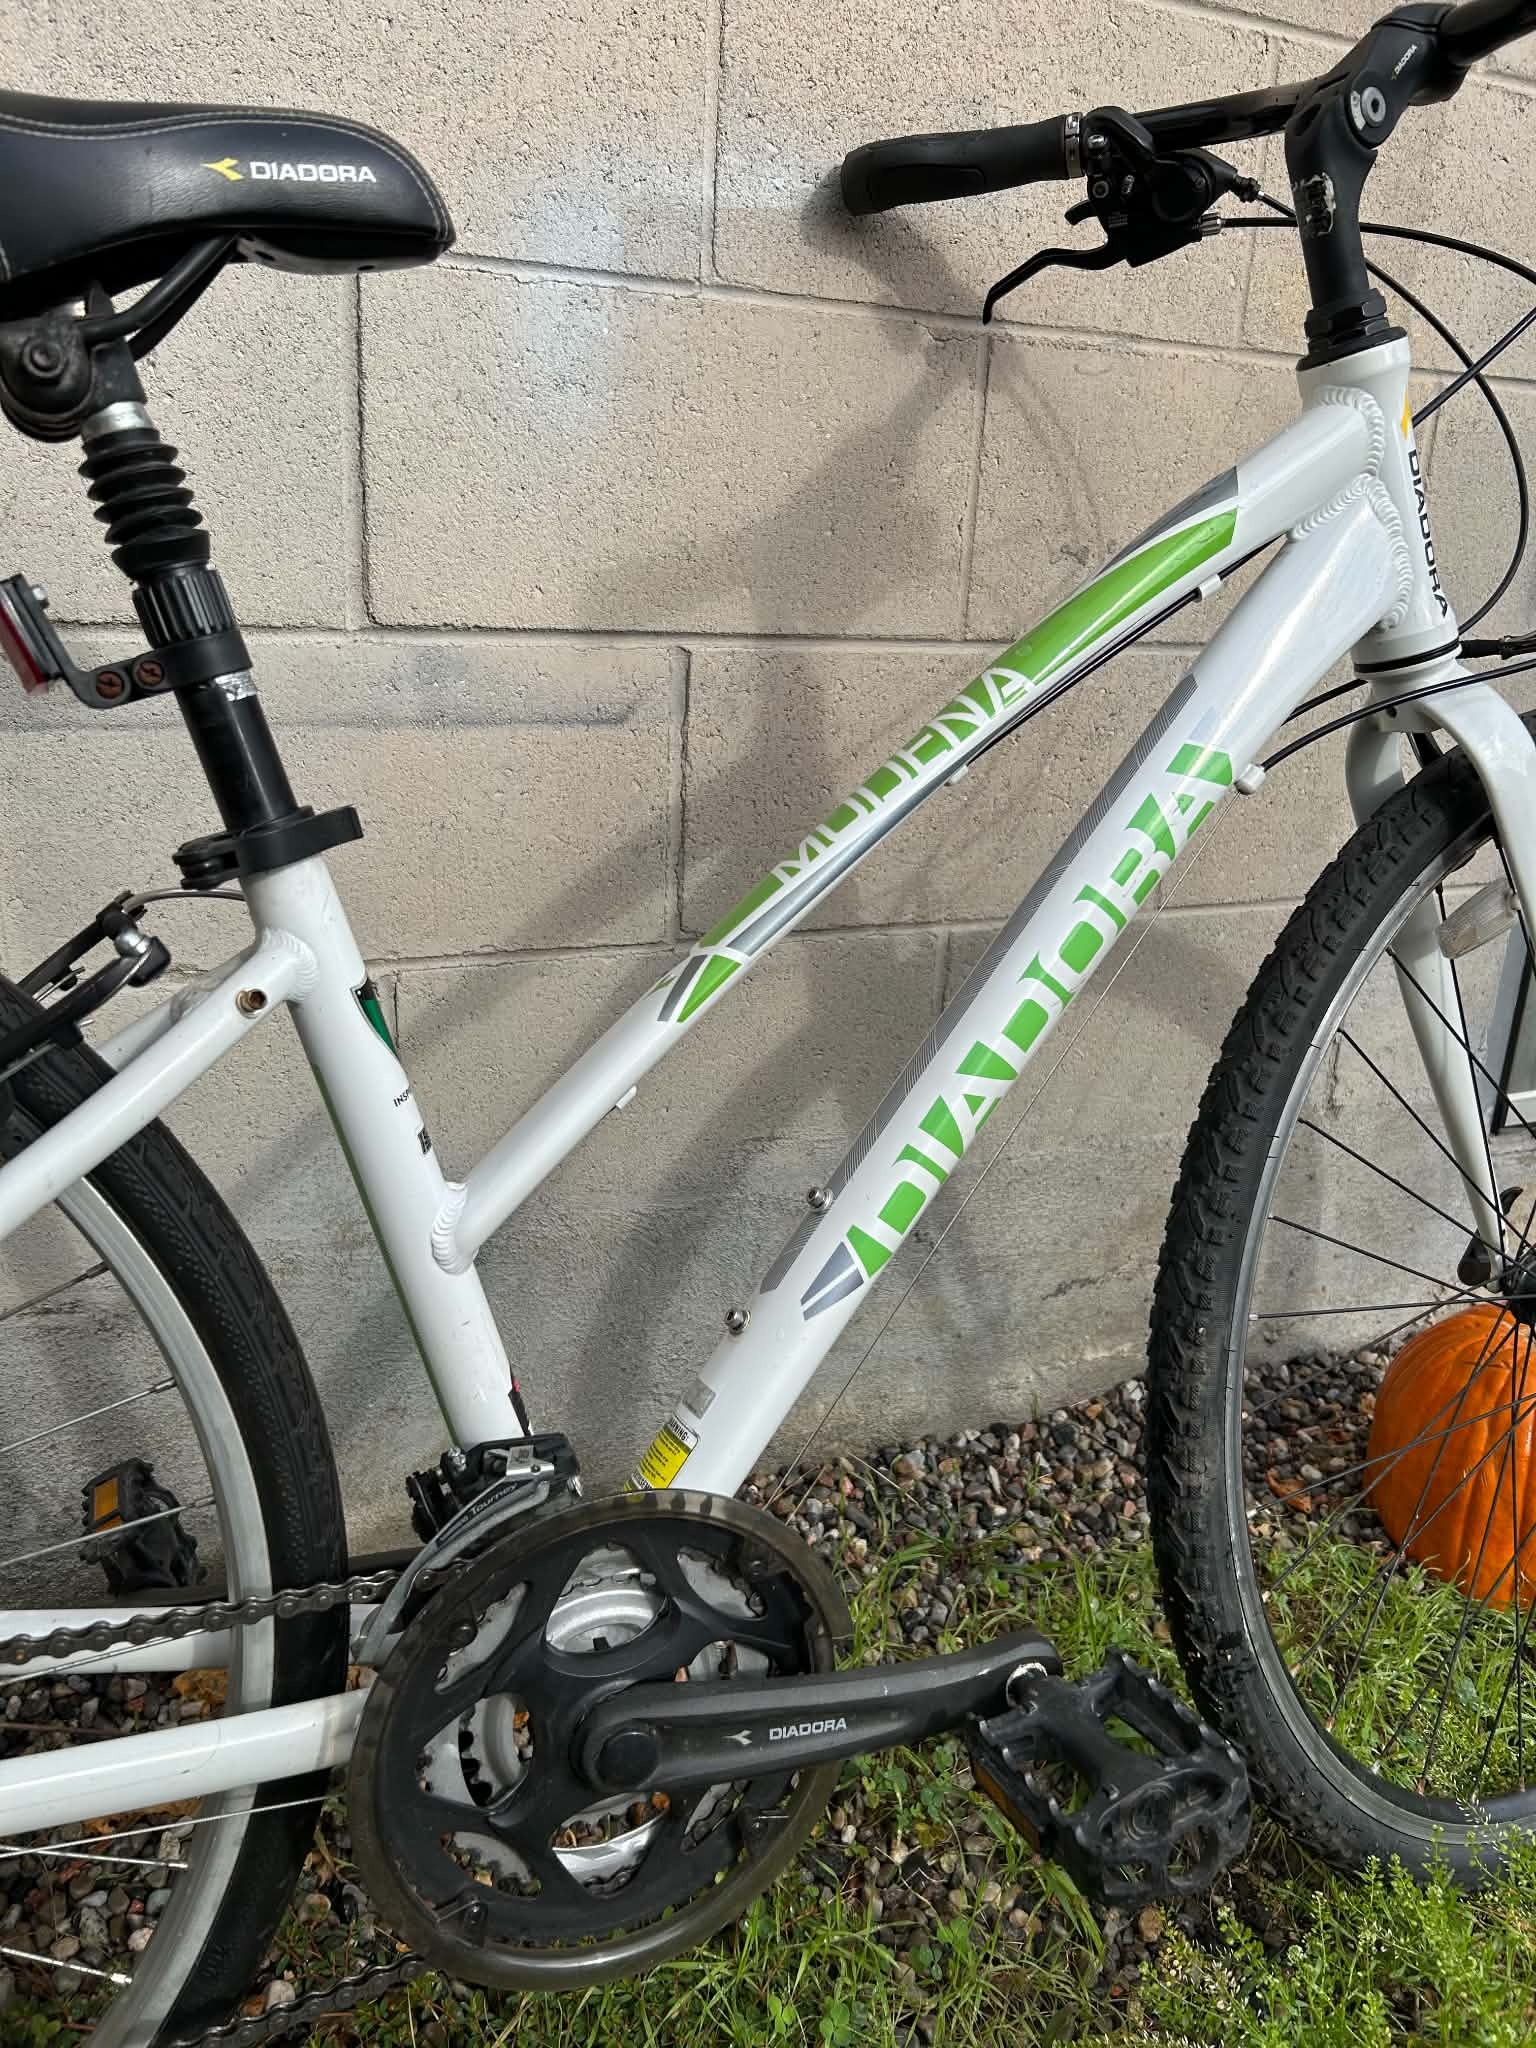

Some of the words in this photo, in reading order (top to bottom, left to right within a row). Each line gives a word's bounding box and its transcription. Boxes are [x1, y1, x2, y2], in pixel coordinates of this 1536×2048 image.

[249, 161, 377, 183] DIADORA
[1407, 449, 1449, 618] DIADORA
[771, 667, 1036, 887] MODENA
[851, 762, 1232, 1258] DIADORA
[769, 1717, 848, 1741] DIADORA
